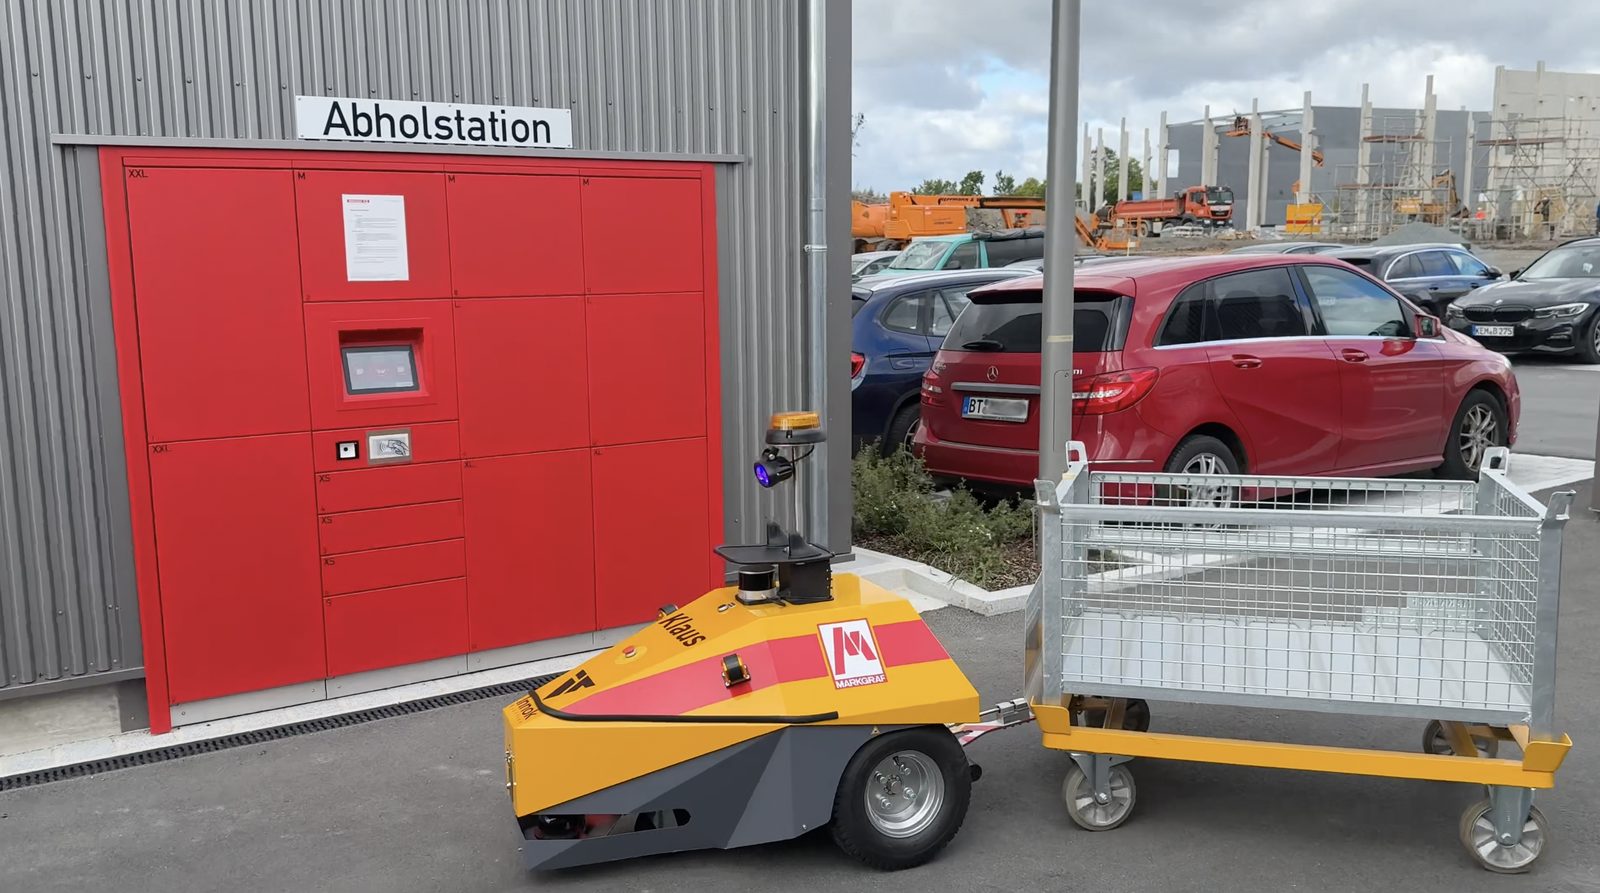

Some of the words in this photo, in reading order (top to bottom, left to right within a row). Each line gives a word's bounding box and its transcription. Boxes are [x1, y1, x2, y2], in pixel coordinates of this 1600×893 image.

[323, 101, 551, 143] Abholstation
[128, 169, 148, 178] XXL
[297, 171, 306, 180] M
[447, 175, 456, 183] M
[968, 398, 984, 414] BT
[319, 474, 331, 482] XS
[321, 516, 333, 524] XS
[324, 557, 336, 566] XS
[658, 613, 706, 647] Klaus
[835, 674, 886, 689] MARKGRAF
